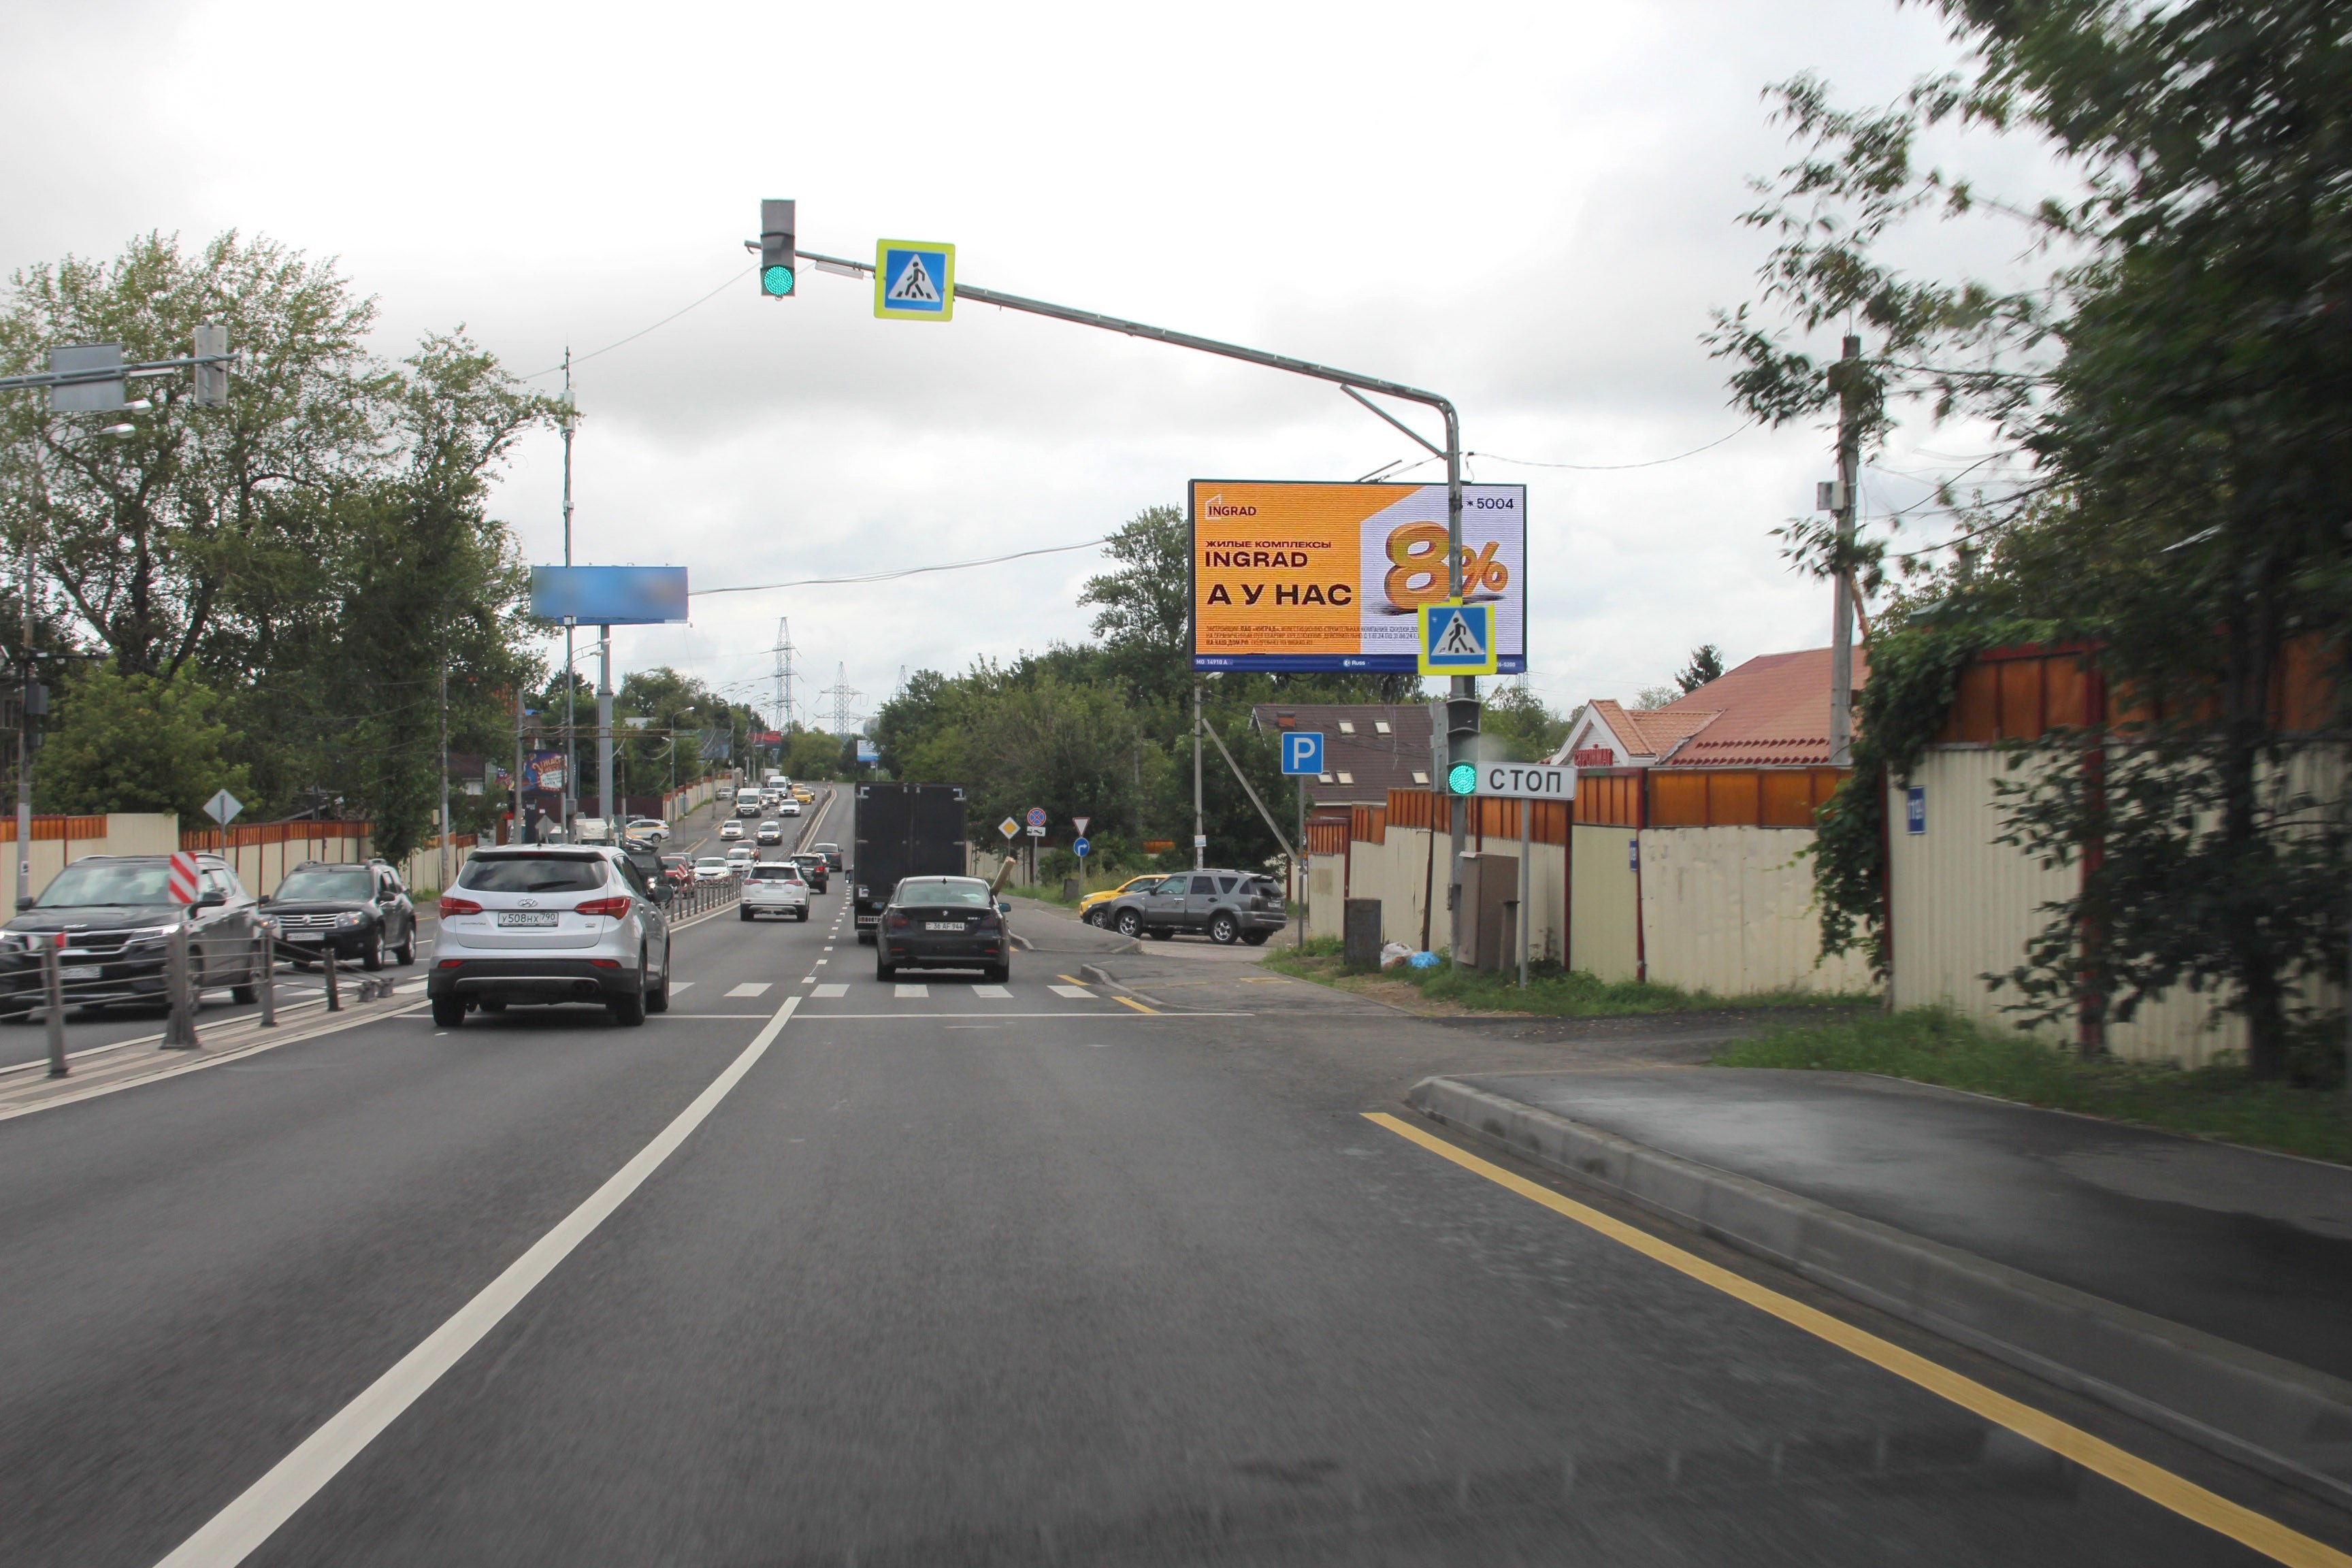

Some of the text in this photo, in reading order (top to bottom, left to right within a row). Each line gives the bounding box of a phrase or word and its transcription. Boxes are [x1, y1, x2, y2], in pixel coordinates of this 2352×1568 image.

[1209, 506, 1257, 516] INGRAD
[1205, 551, 1308, 568] INGRAD
[1207, 583, 1352, 606] А У НАС
[1294, 738, 1316, 769] P
[1490, 768, 1561, 793] СТОП
